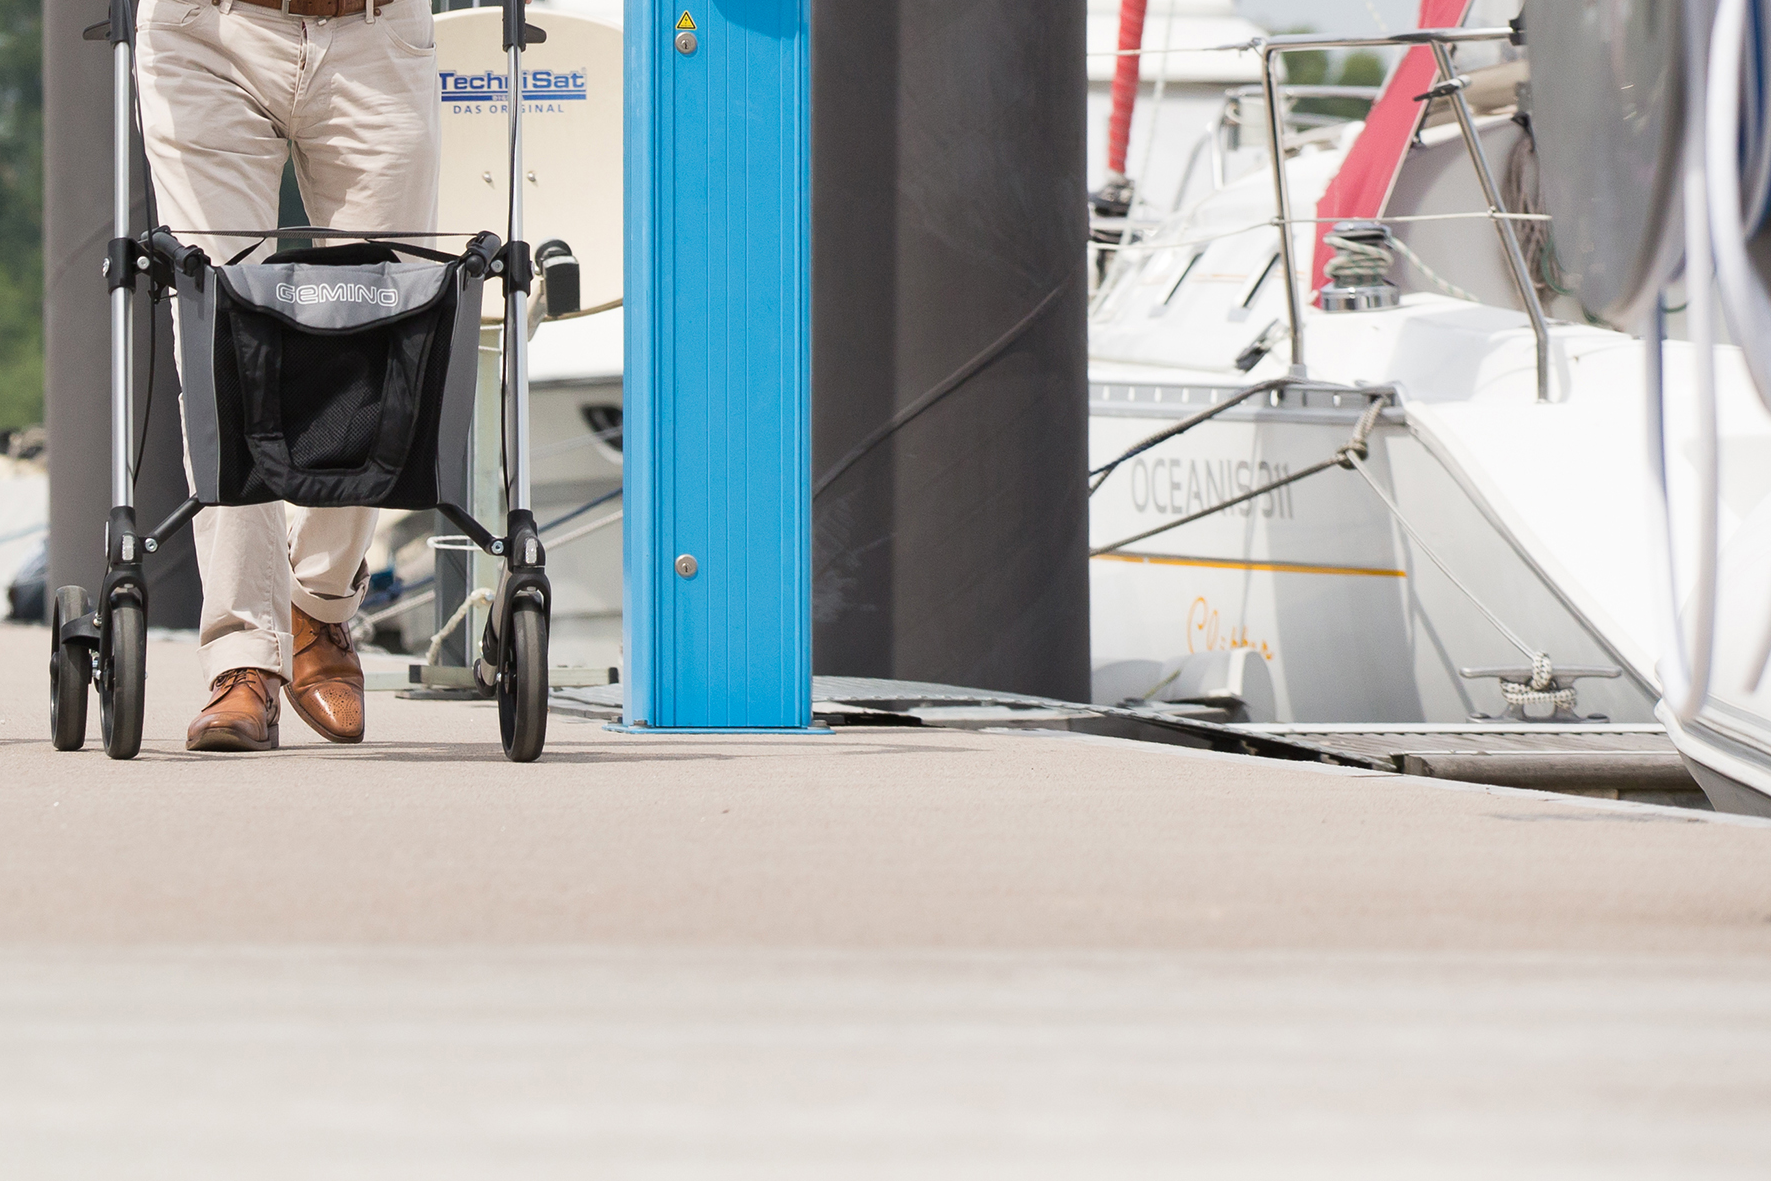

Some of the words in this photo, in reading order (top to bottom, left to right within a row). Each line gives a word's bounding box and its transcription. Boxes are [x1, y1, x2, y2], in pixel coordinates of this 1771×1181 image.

[453, 105, 482, 114] DAS
[489, 104, 565, 114] ORGINAL
[1132, 458, 1253, 517] OCEANIS
